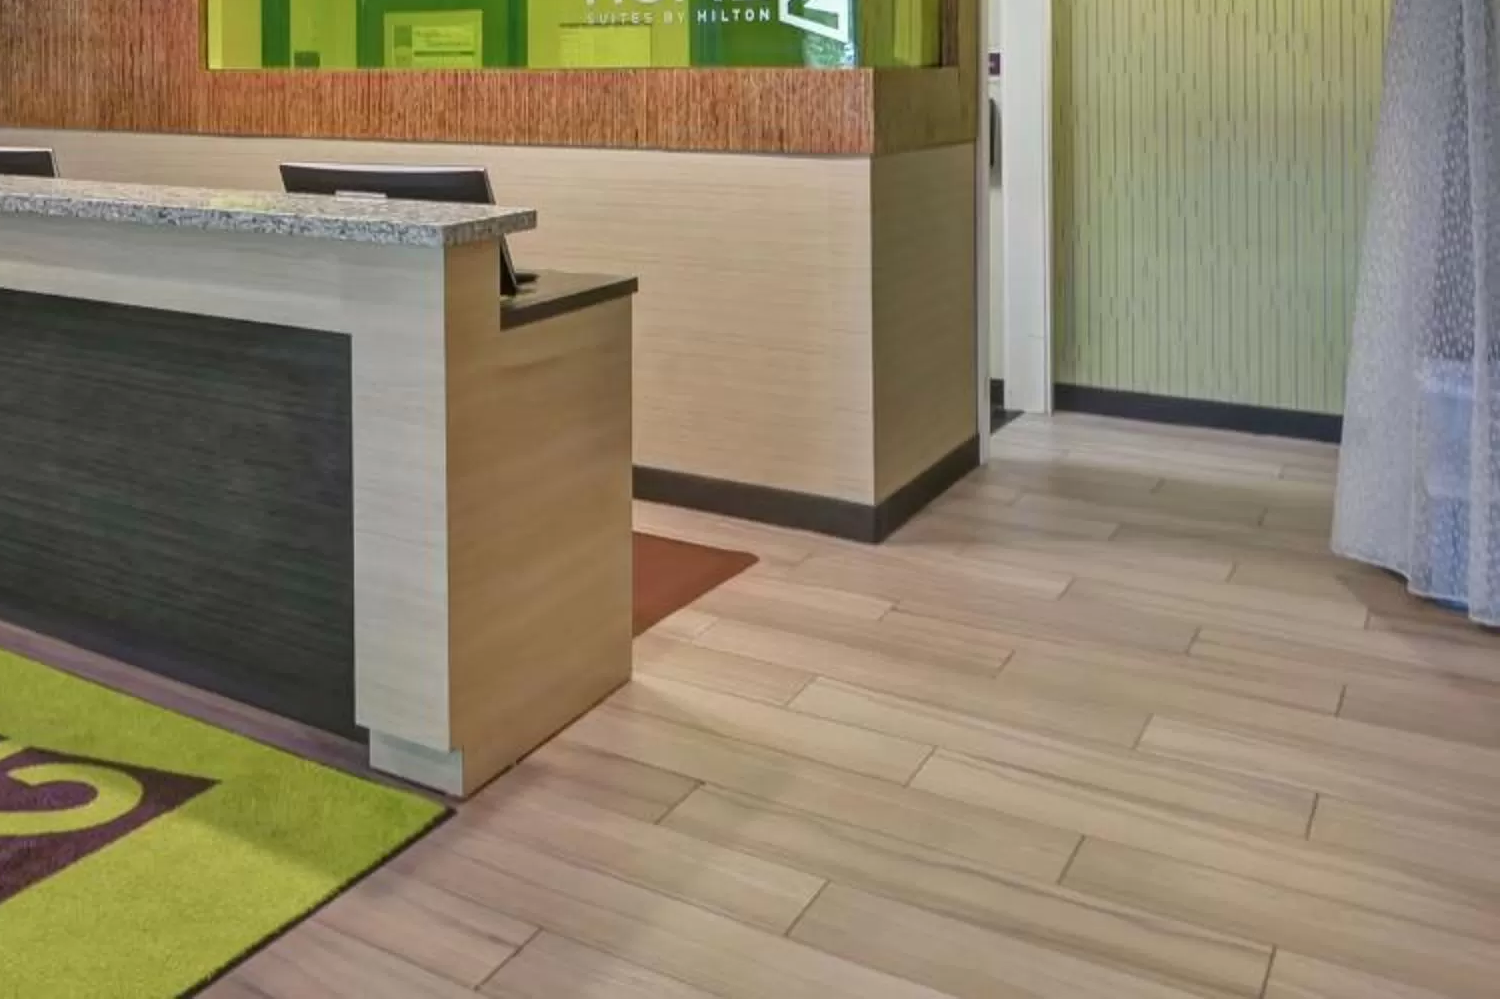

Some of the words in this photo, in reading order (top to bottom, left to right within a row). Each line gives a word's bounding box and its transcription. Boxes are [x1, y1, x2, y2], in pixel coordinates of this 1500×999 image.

[586, 10, 654, 25] SUITES
[663, 10, 686, 25] BY
[696, 8, 771, 23] HILTON
